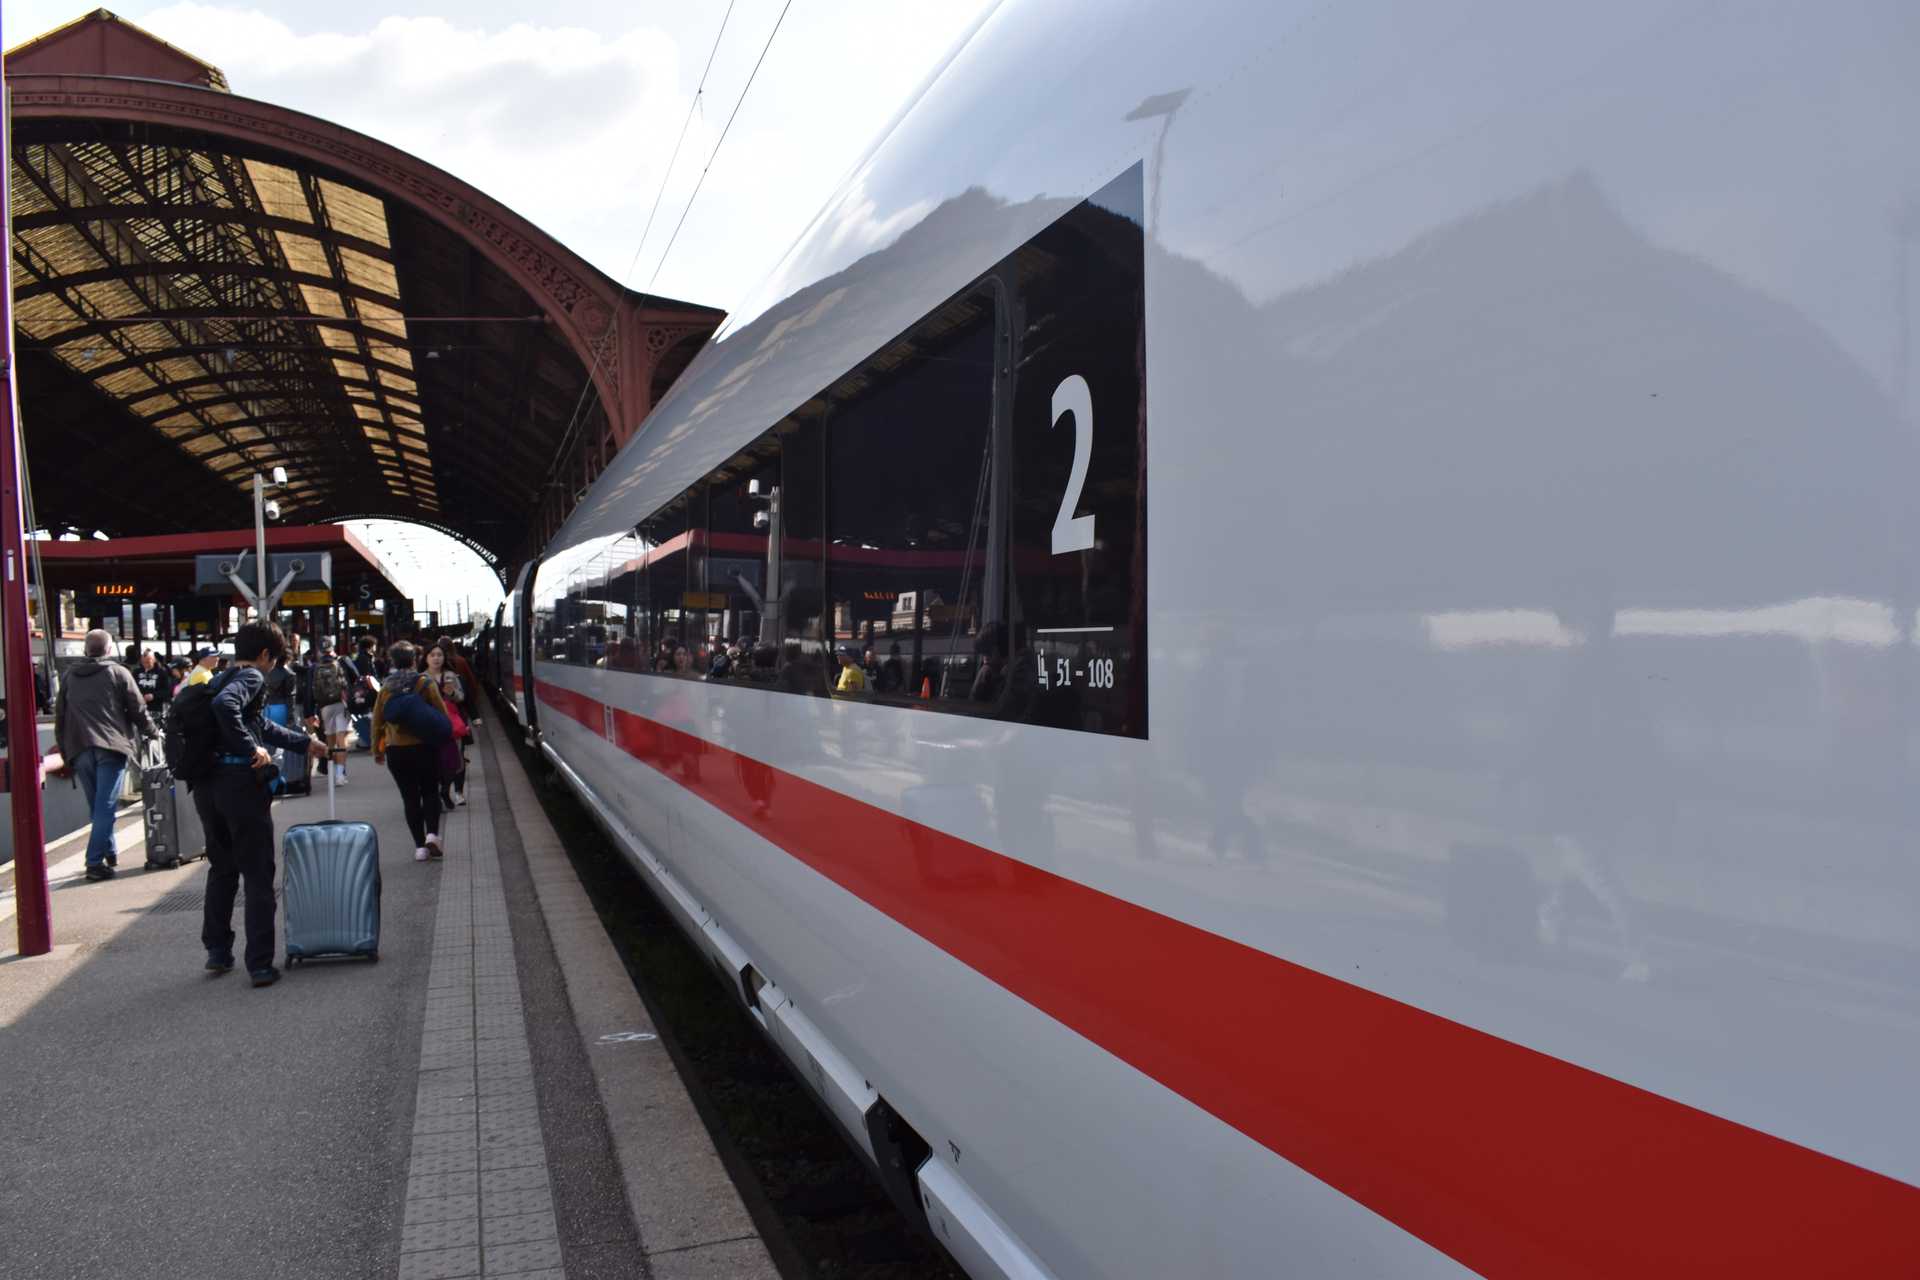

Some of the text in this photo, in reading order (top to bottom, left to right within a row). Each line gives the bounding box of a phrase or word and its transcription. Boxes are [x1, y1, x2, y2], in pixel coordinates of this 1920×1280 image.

[1051, 374, 1095, 555] 2
[1056, 658, 1072, 687] 51
[1088, 658, 1114, 688] 108
